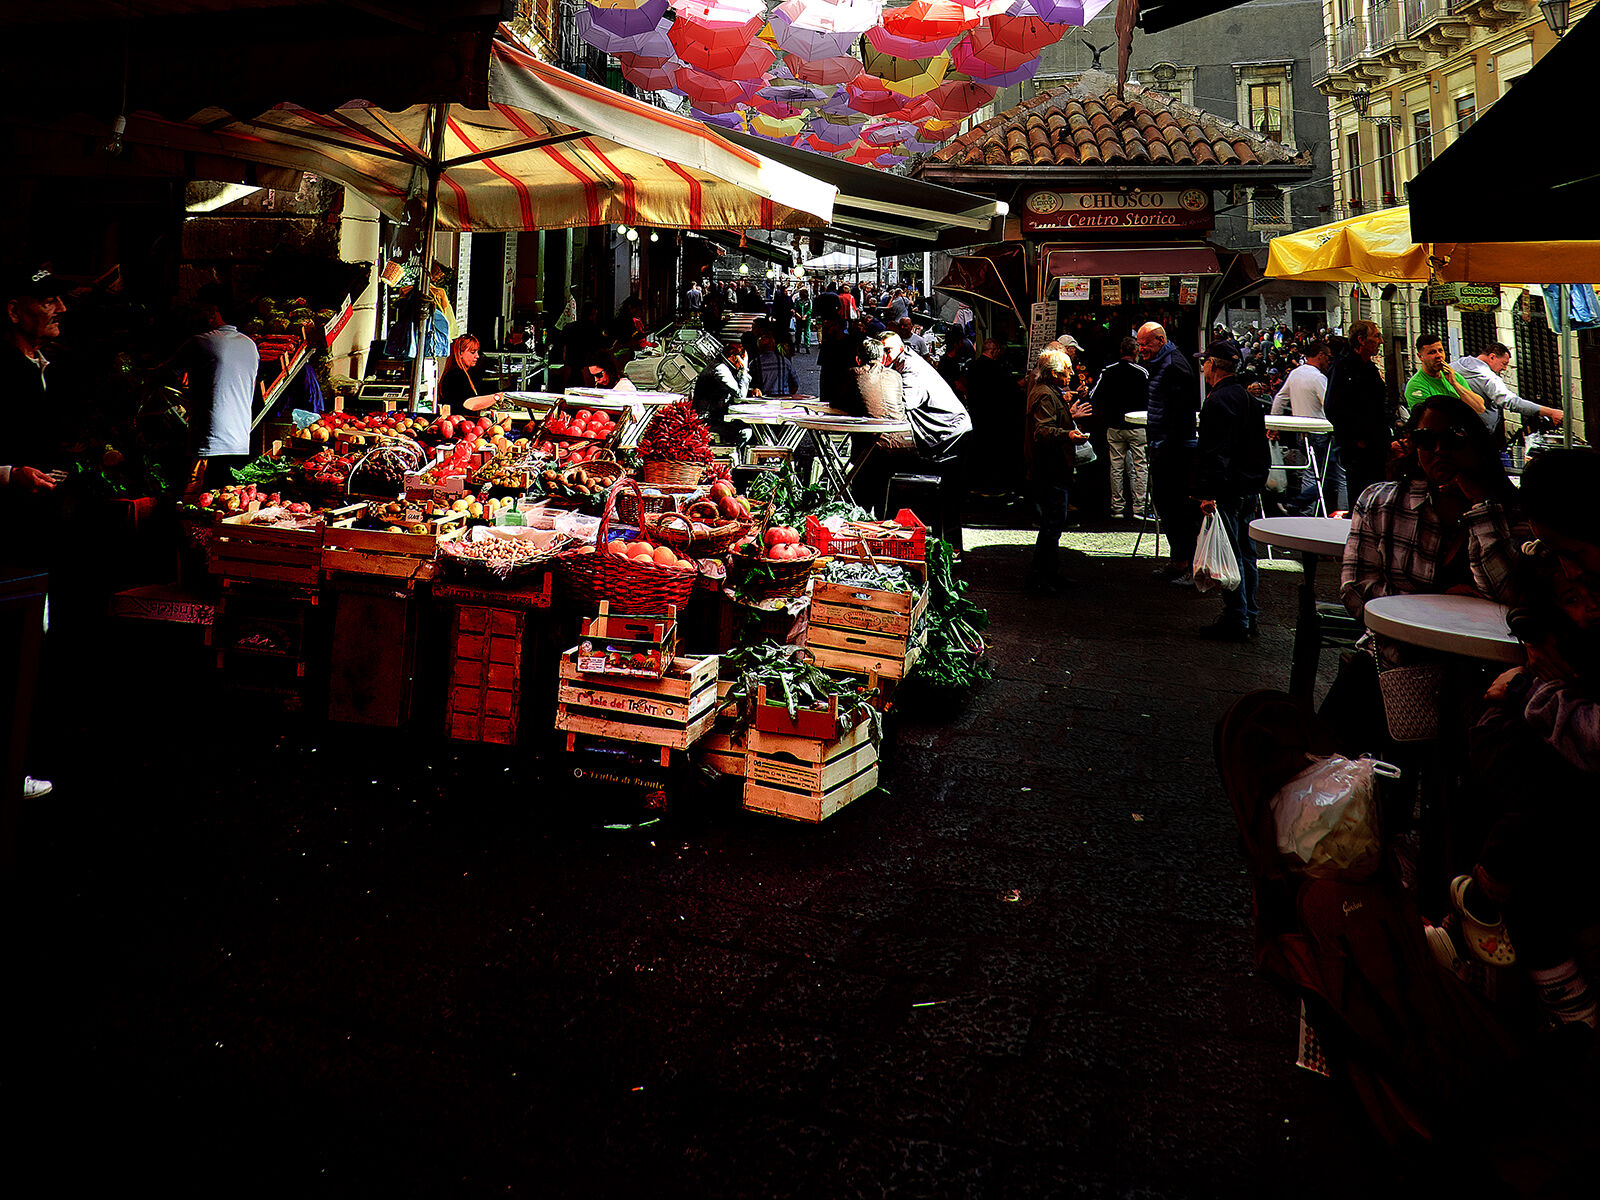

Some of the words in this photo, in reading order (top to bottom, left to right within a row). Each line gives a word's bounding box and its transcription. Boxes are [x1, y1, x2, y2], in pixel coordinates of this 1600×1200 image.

[1079, 192, 1164, 209] CHIOSCO
[1067, 213, 1119, 227] Centro
[1122, 211, 1176, 227] Storico
[577, 691, 607, 706] Mele
